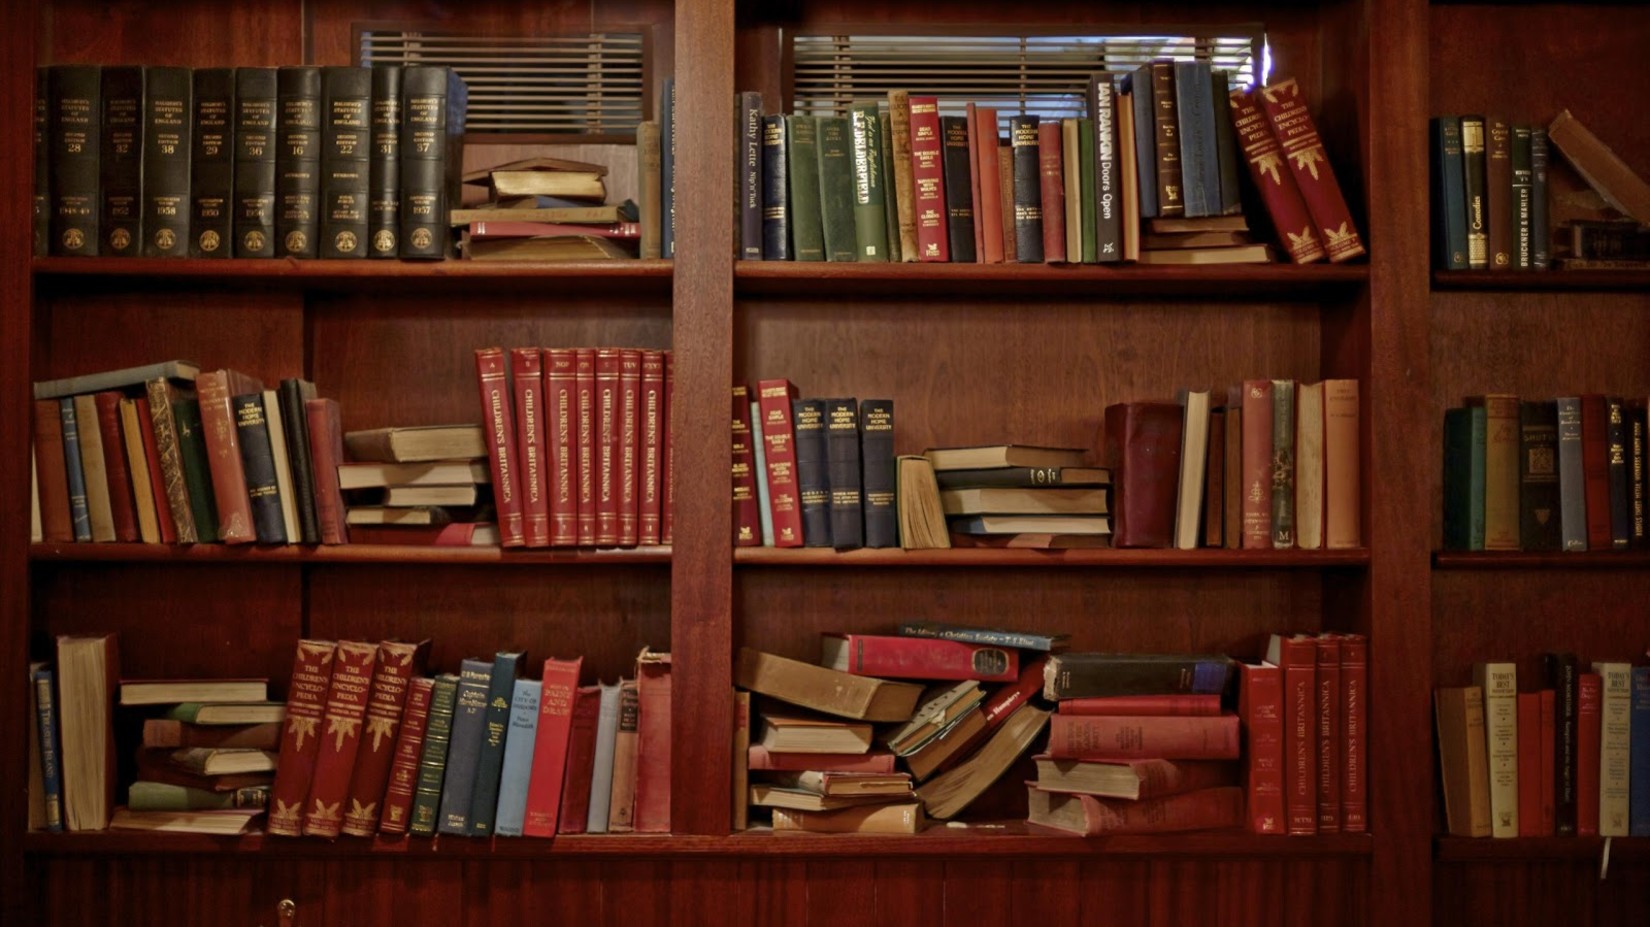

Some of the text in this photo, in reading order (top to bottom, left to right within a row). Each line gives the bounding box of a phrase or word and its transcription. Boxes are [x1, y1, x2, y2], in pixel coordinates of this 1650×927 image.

[1241, 105, 1255, 115] THE
[1280, 100, 1294, 110] THE
[749, 108, 759, 139] Kathy
[69, 144, 83, 154] 28
[161, 145, 176, 155] 38
[206, 146, 219, 156] 29
[249, 147, 263, 156] 36
[292, 146, 305, 156] 16
[340, 145, 354, 155] 22
[416, 142, 430, 152] 37
[1098, 82, 1113, 219] IAN RANKIN Doors Open
[748, 141, 759, 167] Lette
[1520, 188, 1529, 219] MAHLER
[1473, 196, 1482, 230] Comedies
[1520, 227, 1529, 268] BRUCKNER
[624, 361, 638, 369] TUV
[498, 446, 512, 504] BRITANNICA
[527, 446, 538, 503] BRITANNICA
[559, 446, 569, 503] BRITANNICA
[581, 446, 591, 503] BRITANNICA
[602, 446, 612, 503] BRITANNICA
[624, 446, 634, 503] BRITANNICA
[646, 447, 656, 504] BRITANNICA
[1279, 532, 1289, 541] M
[945, 630, 974, 640] Christian
[975, 633, 999, 644] Society
[304, 665, 320, 674] THE
[345, 665, 360, 674] THE
[383, 665, 398, 675] THE
[1492, 672, 1515, 681] TODAY'S
[1607, 672, 1630, 680] TODAY'S
[1496, 680, 1511, 689] BEST
[1611, 680, 1626, 688] BEST
[296, 691, 318, 701] PEDIA
[336, 692, 359, 702] PEDIA
[544, 689, 571, 699] PAINT
[546, 698, 568, 708] AND
[1348, 679, 1357, 736] BRITANNICA
[542, 706, 571, 717] DRAW
[1297, 681, 1305, 738] BRITANNICA
[1321, 680, 1330, 737] BRITANNICA
